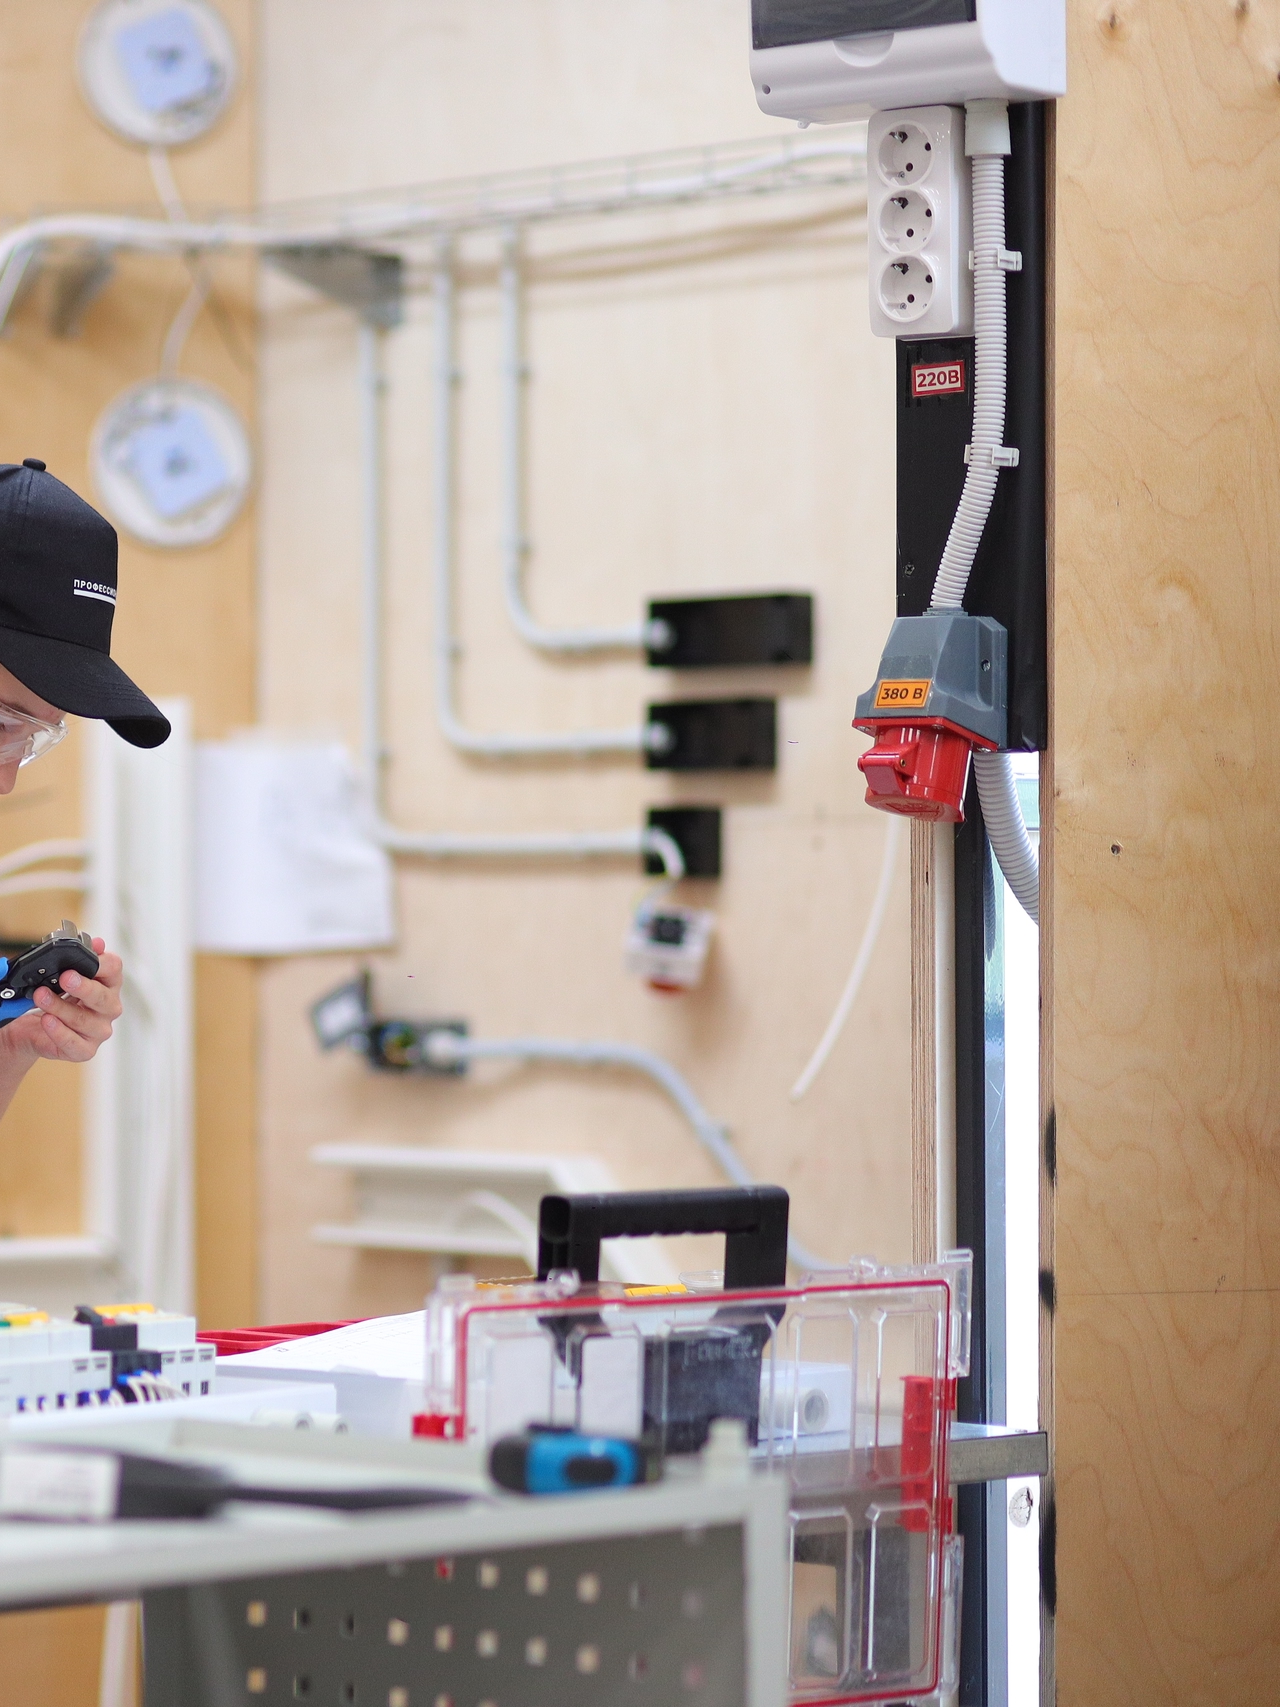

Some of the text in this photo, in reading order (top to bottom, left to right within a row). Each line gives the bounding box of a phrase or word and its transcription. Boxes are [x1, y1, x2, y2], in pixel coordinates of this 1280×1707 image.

[917, 370, 959, 388] 220В
[881, 688, 923, 699] 380 В
